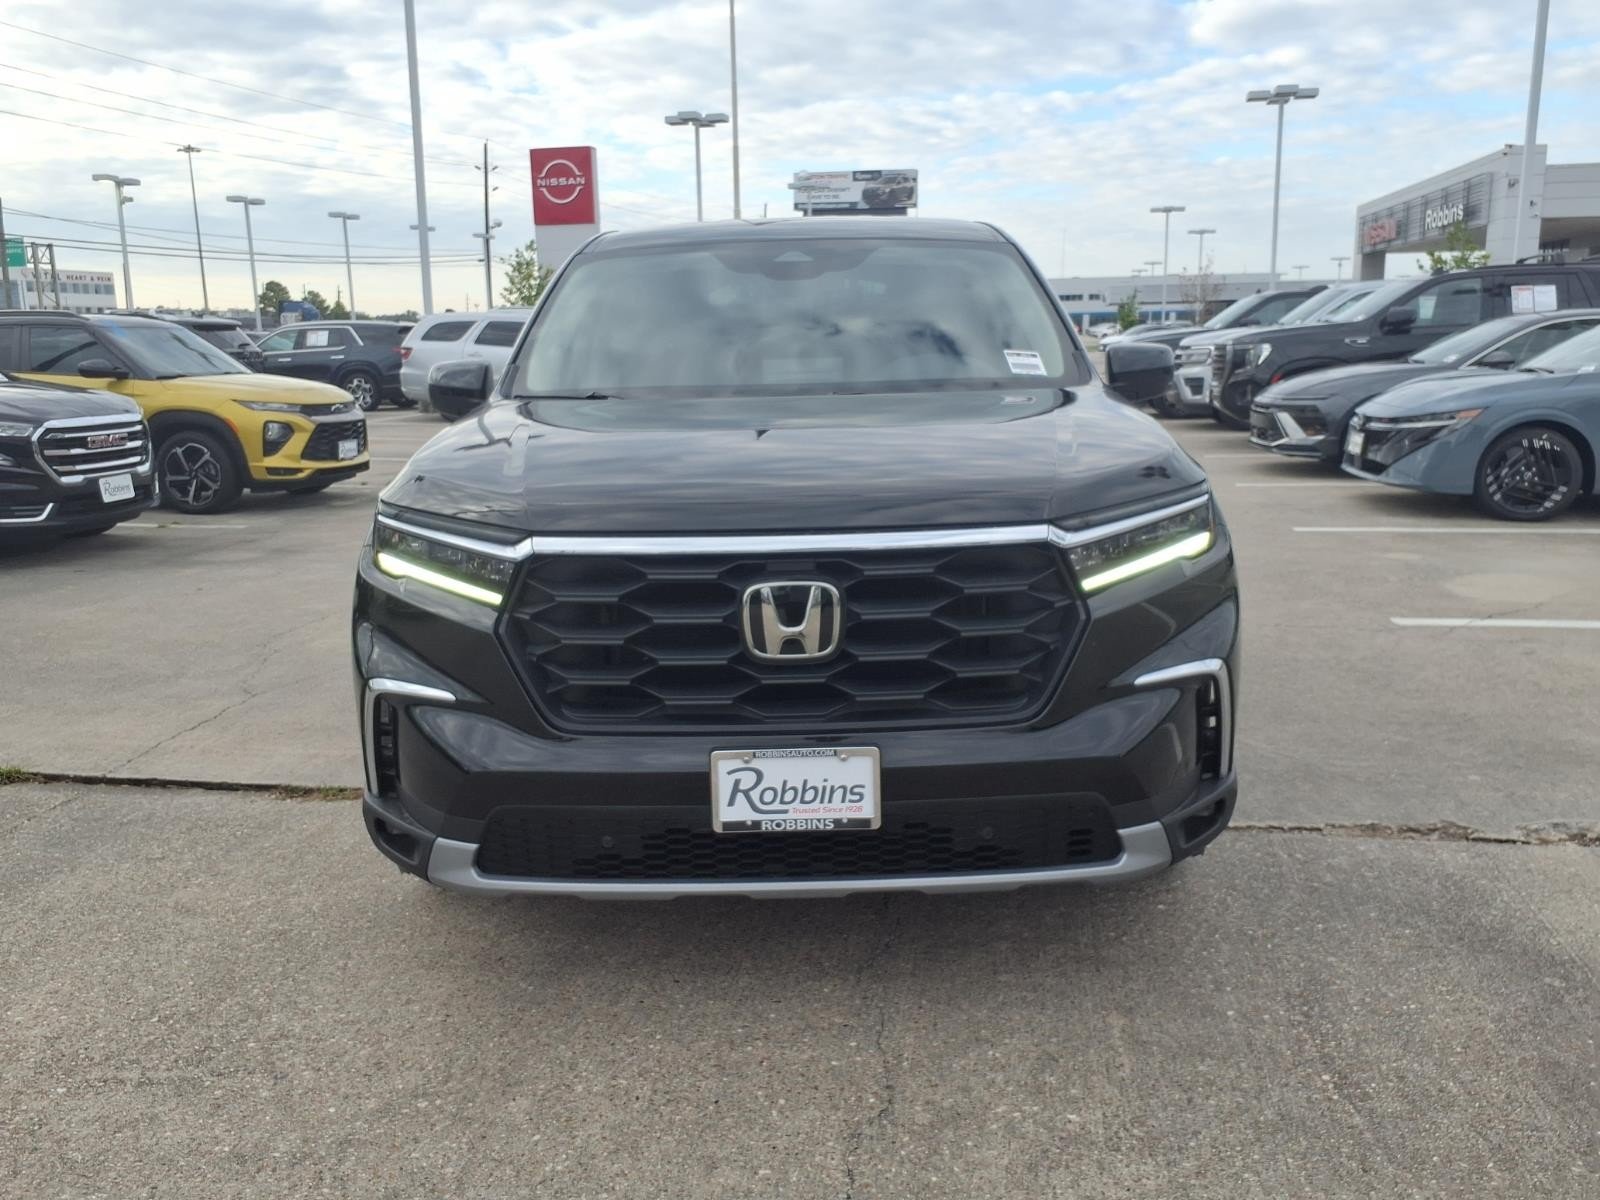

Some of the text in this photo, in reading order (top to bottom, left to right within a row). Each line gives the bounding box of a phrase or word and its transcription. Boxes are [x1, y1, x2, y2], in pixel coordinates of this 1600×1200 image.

[537, 176, 585, 187] NISSAN
[1425, 203, 1464, 230] Robbins
[87, 432, 129, 449] GMC
[755, 749, 835, 758] ROBBINSAUTO.COM
[726, 766, 866, 815] Robbins
[792, 806, 821, 815] Trusted
[823, 805, 844, 813] Since
[761, 818, 835, 831] ROBBINS
